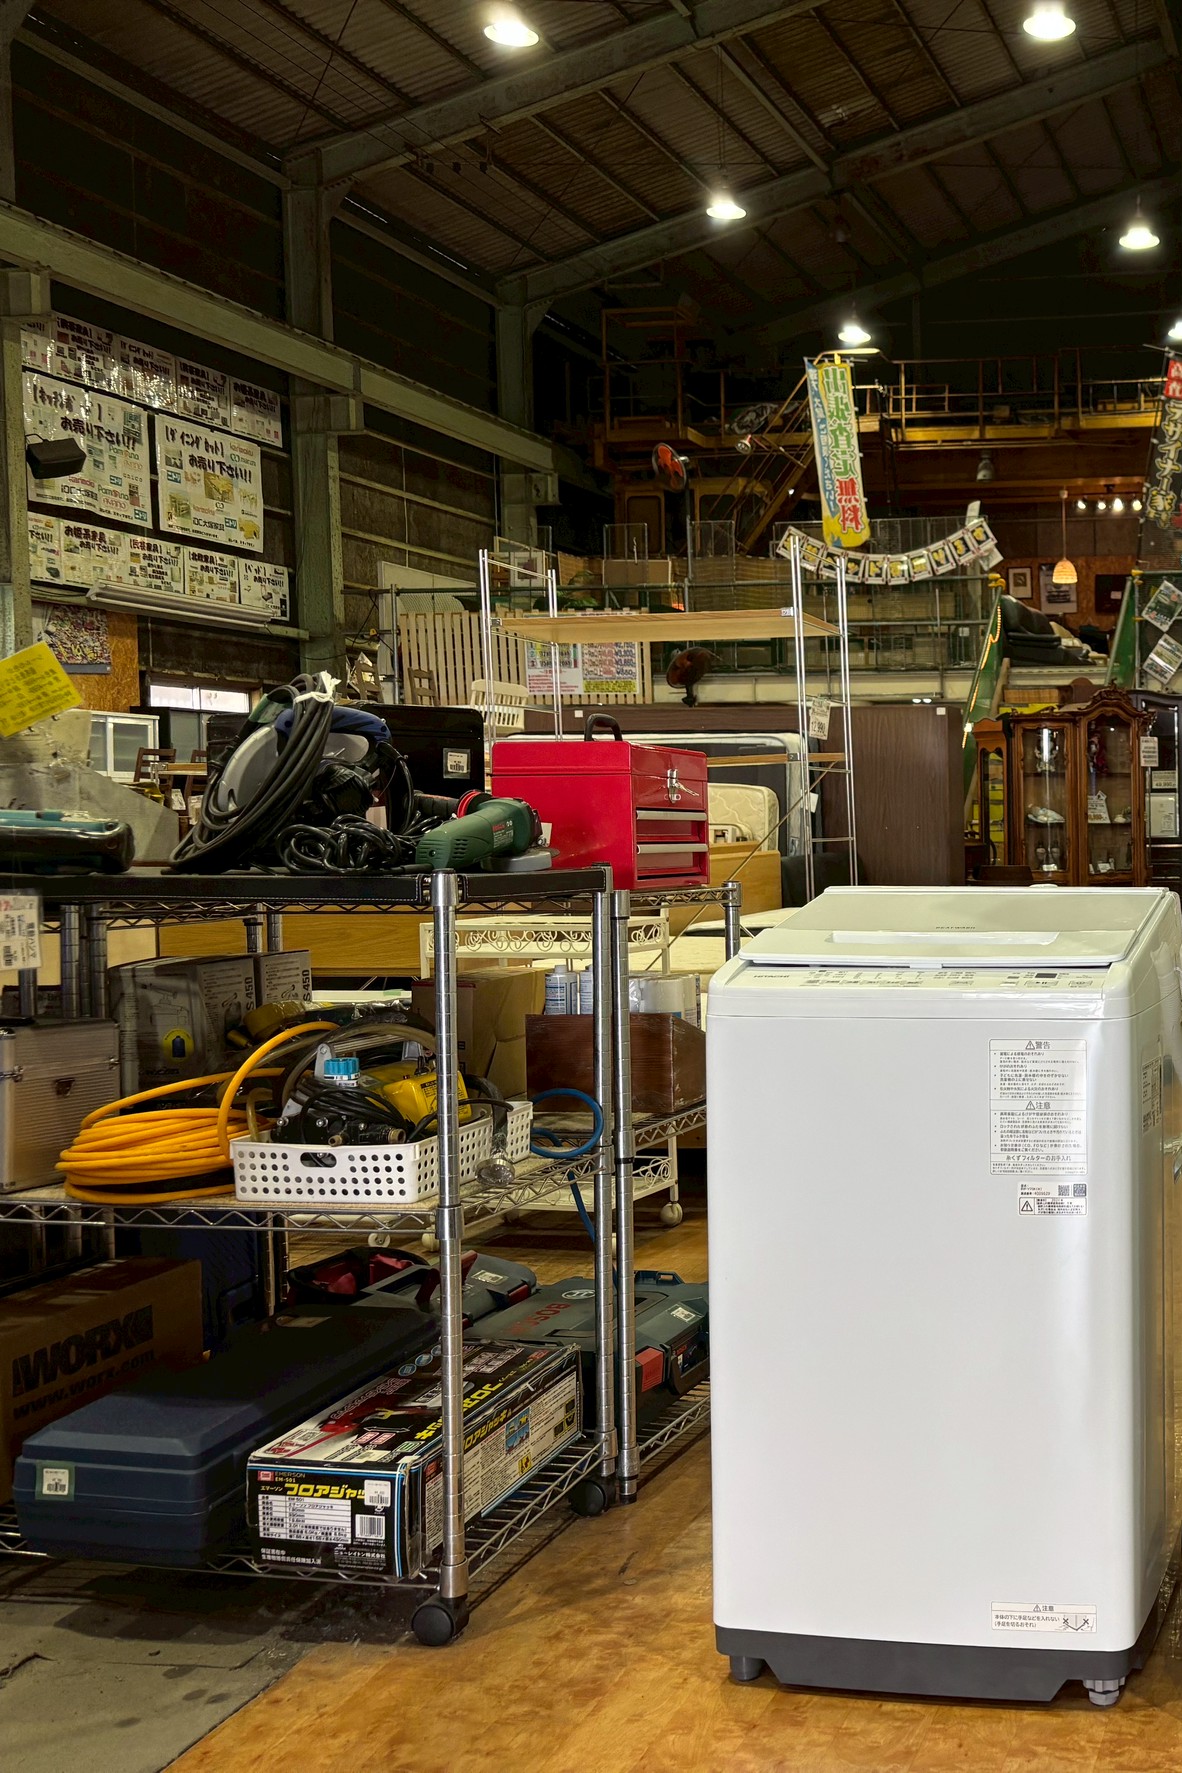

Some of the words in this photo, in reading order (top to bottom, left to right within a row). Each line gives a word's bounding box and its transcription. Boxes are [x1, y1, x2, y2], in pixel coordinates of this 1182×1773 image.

[1035, 1041, 1051, 1050] 警告
[284, 1483, 365, 1499] フロアジャッ
